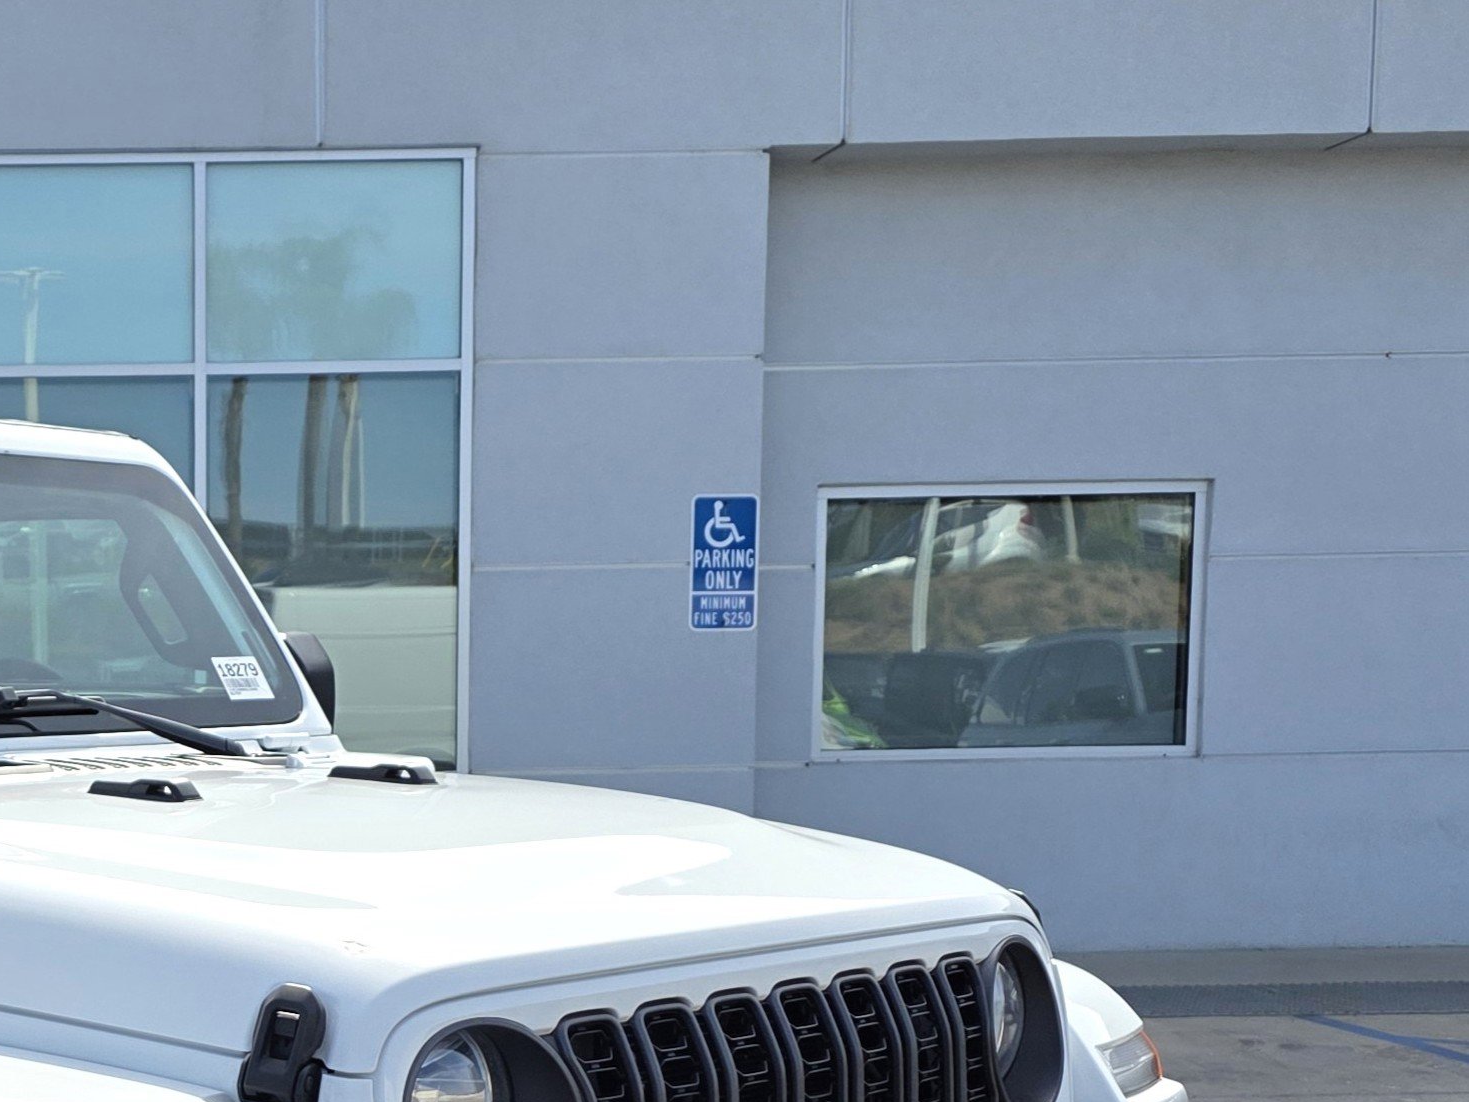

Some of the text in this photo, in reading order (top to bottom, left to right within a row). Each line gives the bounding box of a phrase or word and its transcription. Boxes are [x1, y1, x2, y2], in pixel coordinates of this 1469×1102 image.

[694, 548, 755, 568] PARKING
[705, 570, 743, 590] ONLY
[700, 596, 747, 610] MINIMUM
[694, 611, 752, 626] FINE $250
[217, 662, 259, 677] 18279
